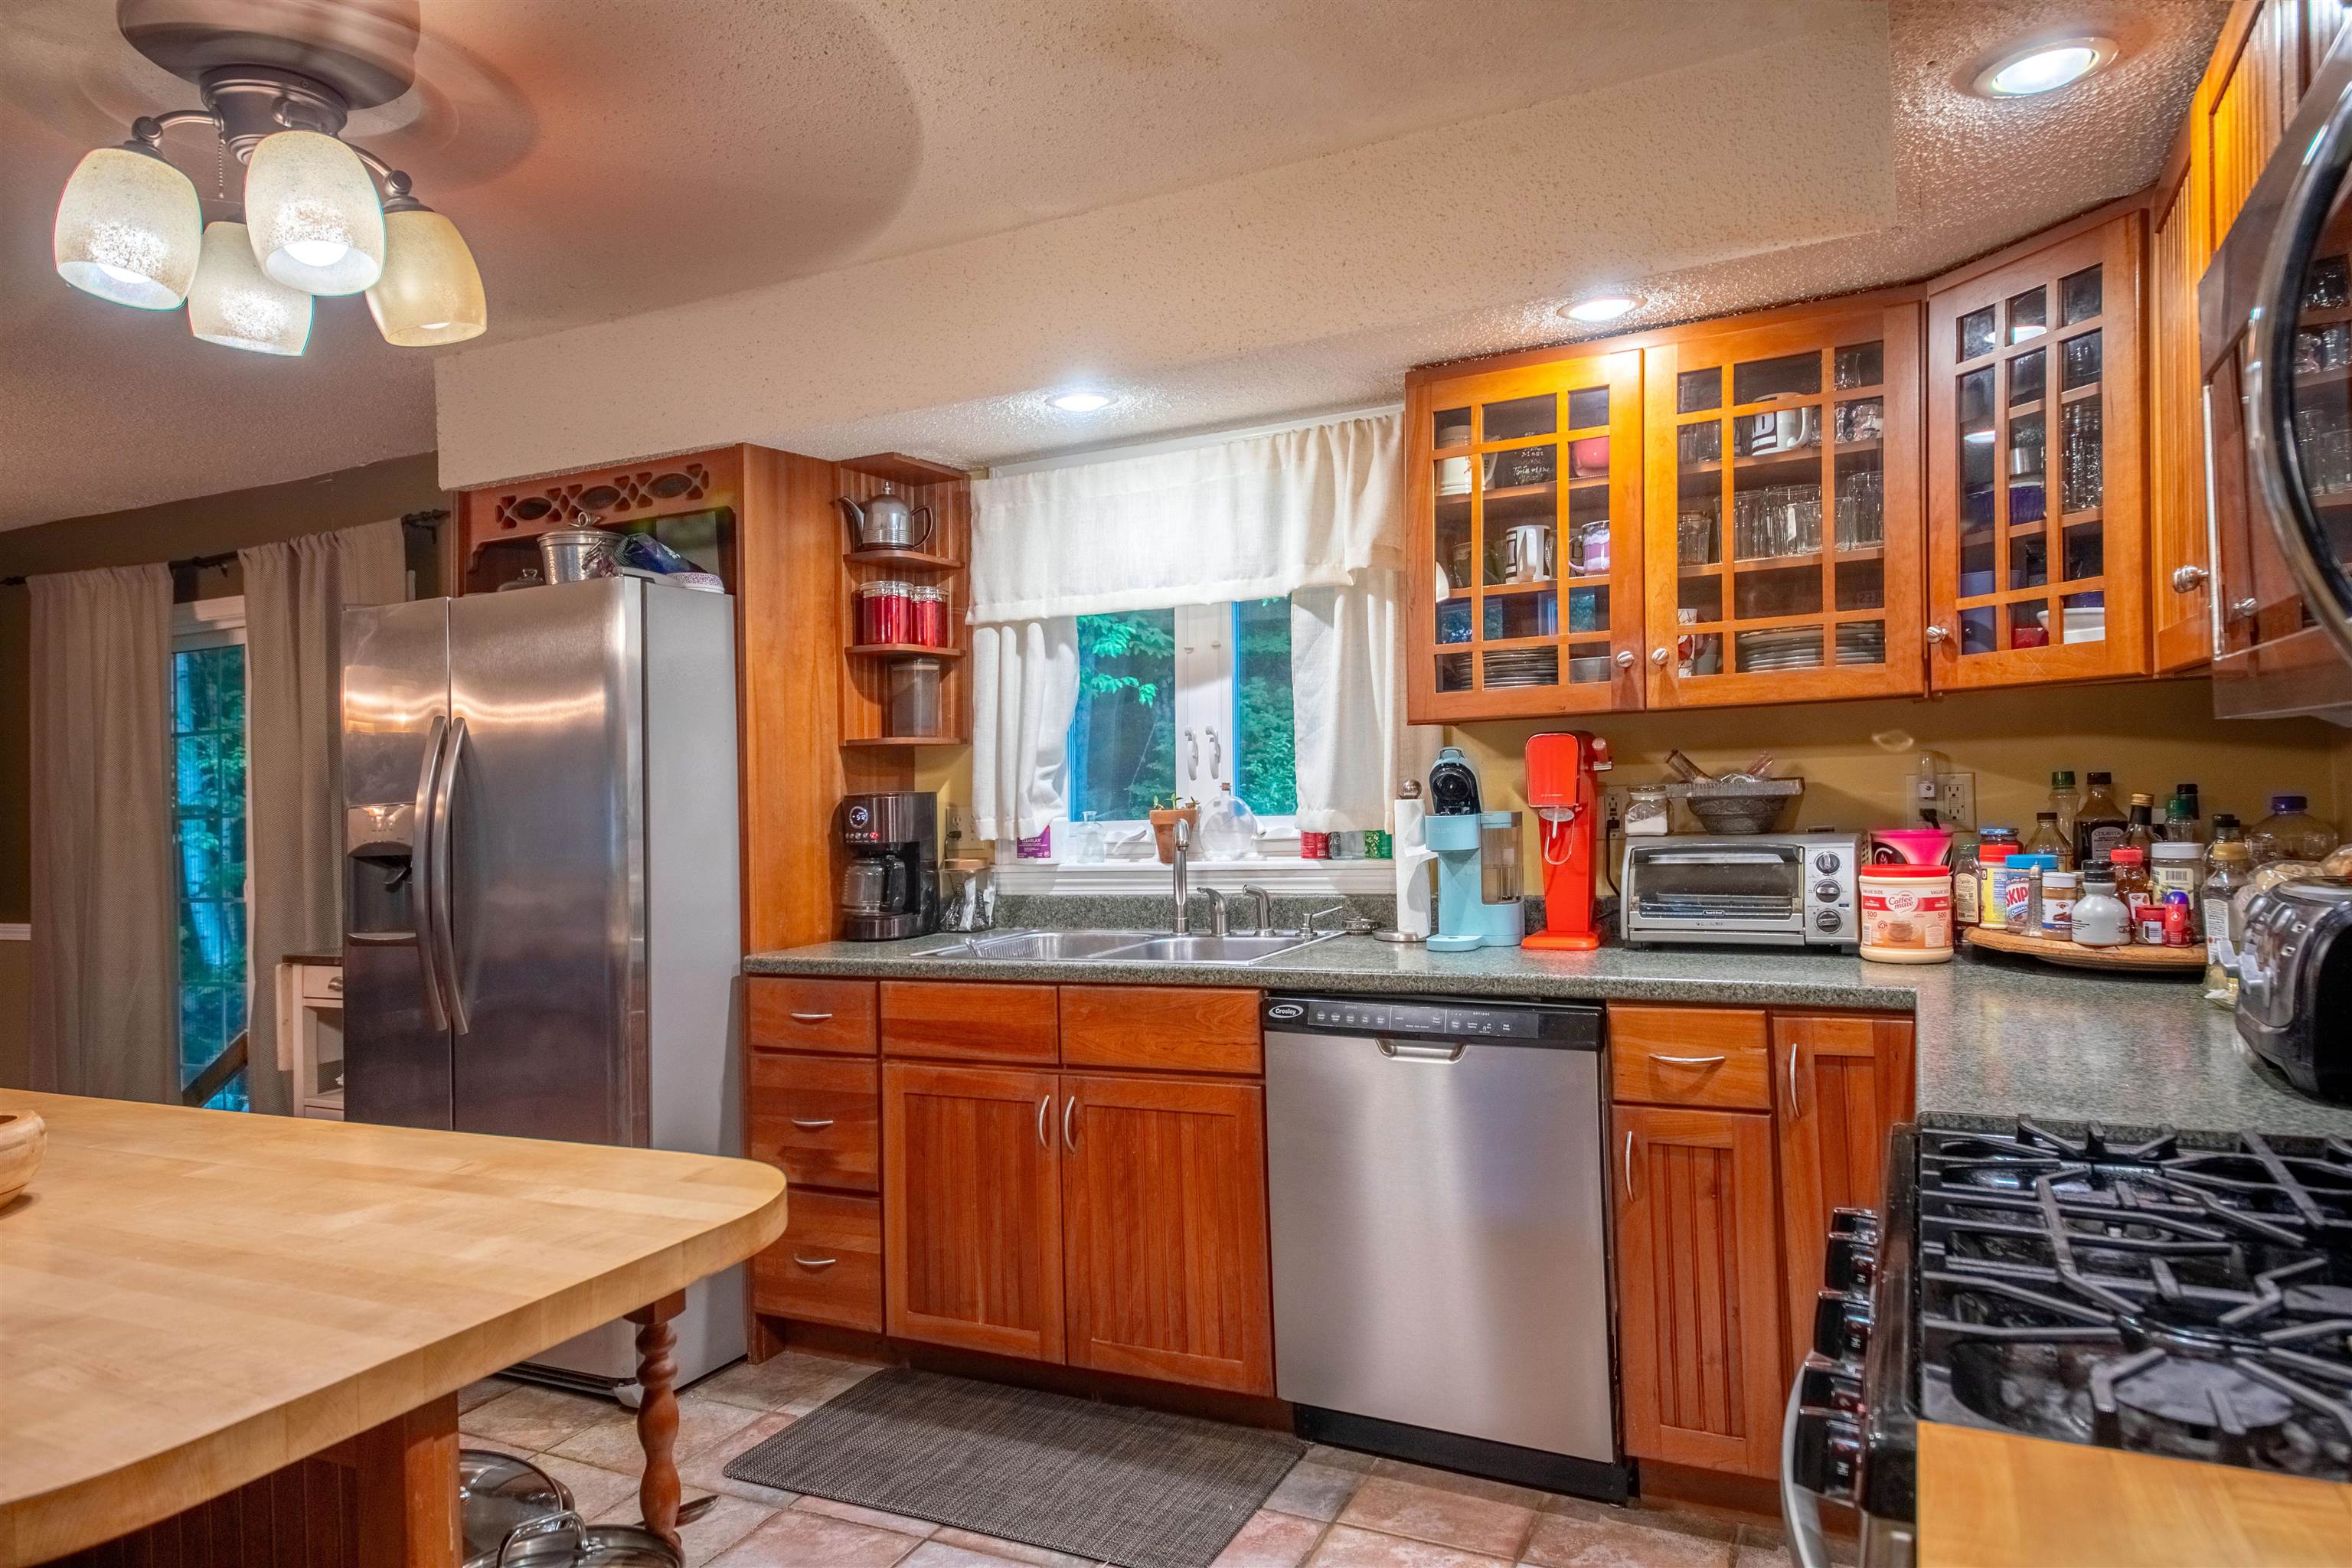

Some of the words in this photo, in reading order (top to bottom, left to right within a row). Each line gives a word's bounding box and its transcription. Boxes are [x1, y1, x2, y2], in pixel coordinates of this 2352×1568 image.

[1888, 897, 1913, 905] Coffee
[2006, 887, 2029, 907] SKIP
[1275, 1008, 1297, 1016] Crosley
